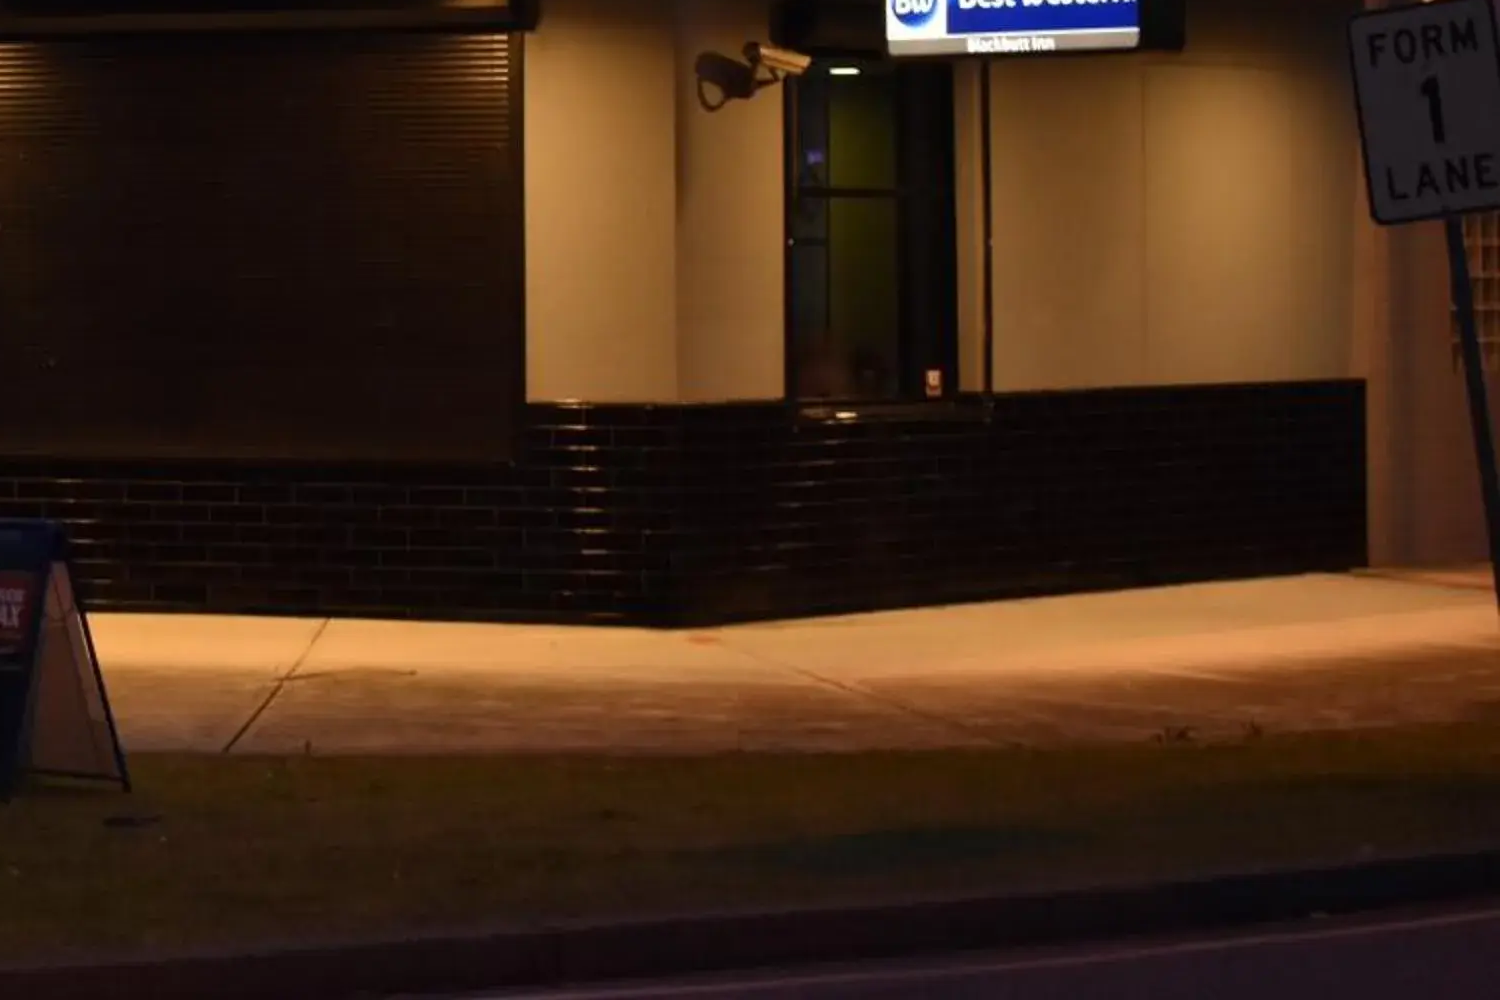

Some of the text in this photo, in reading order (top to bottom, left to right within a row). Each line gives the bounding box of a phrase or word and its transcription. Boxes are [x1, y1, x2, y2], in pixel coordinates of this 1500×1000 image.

[1367, 18, 1478, 67] FORM
[1421, 75, 1445, 143] 1
[1386, 153, 1499, 200] LANE
